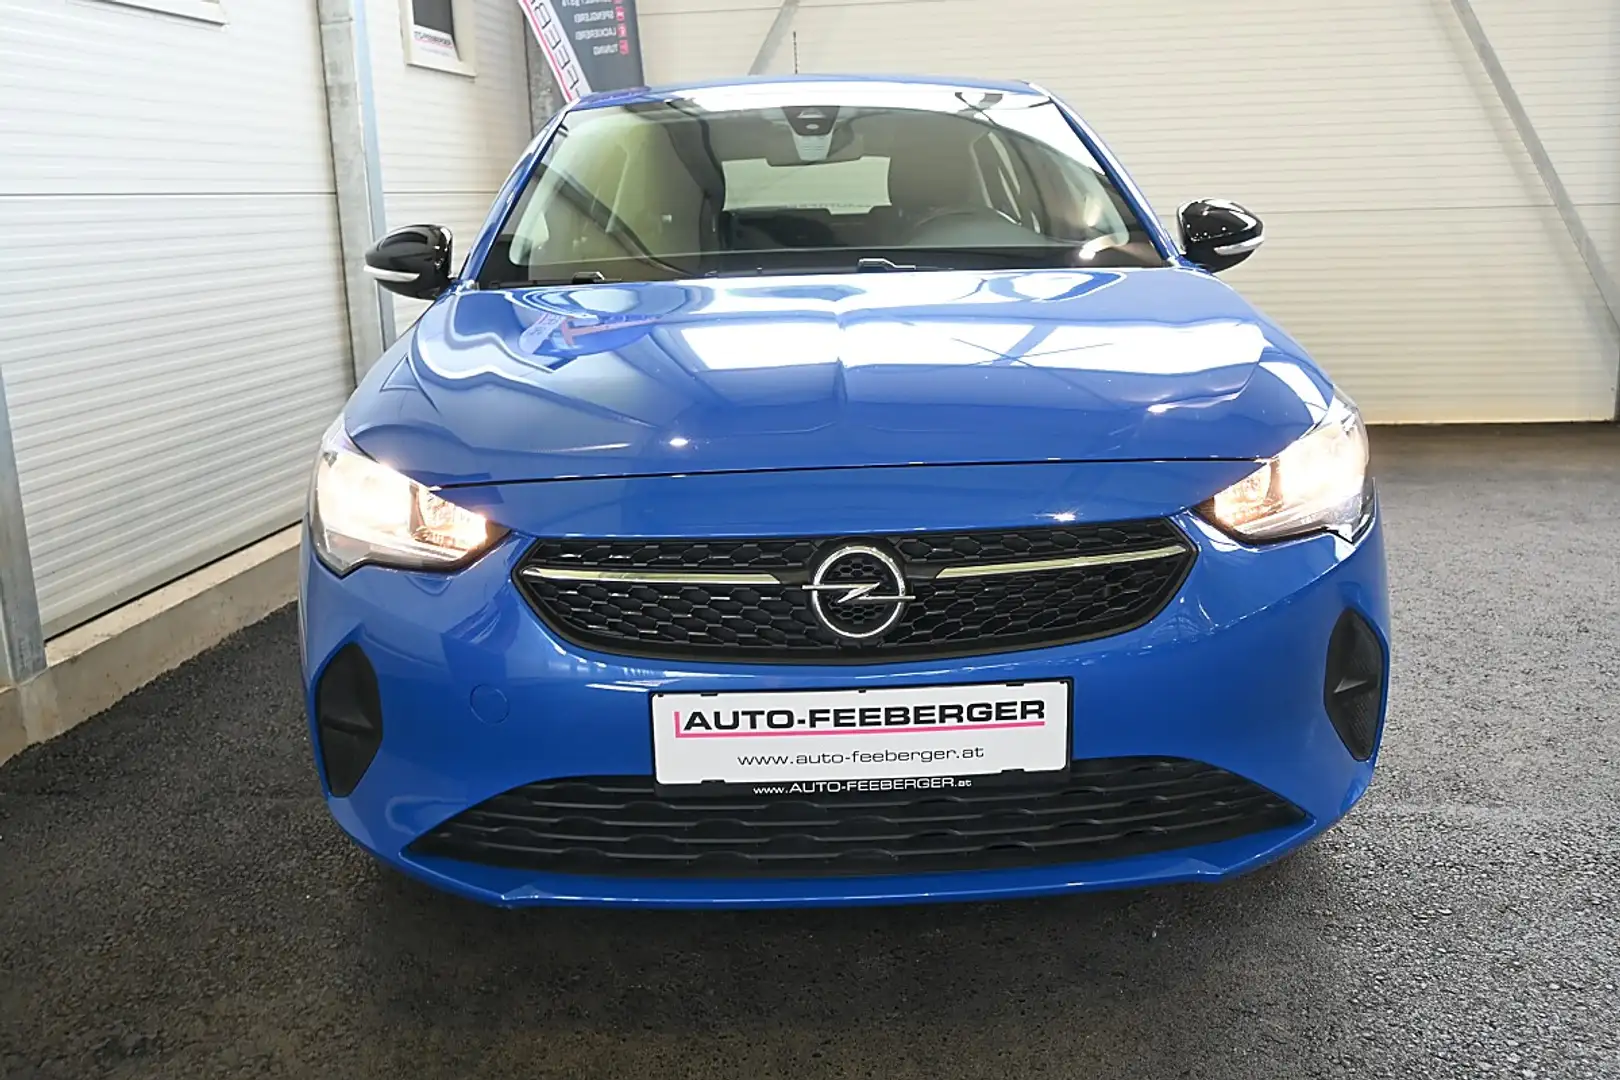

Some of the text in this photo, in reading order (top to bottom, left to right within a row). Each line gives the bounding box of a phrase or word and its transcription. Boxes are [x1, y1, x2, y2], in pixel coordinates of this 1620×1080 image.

[683, 699, 1046, 732] AUTO-FEEBERGER
[737, 747, 985, 766] www.auto-feeberger.at
[752, 776, 973, 795] www.AUTO-FEEBERGER.at
